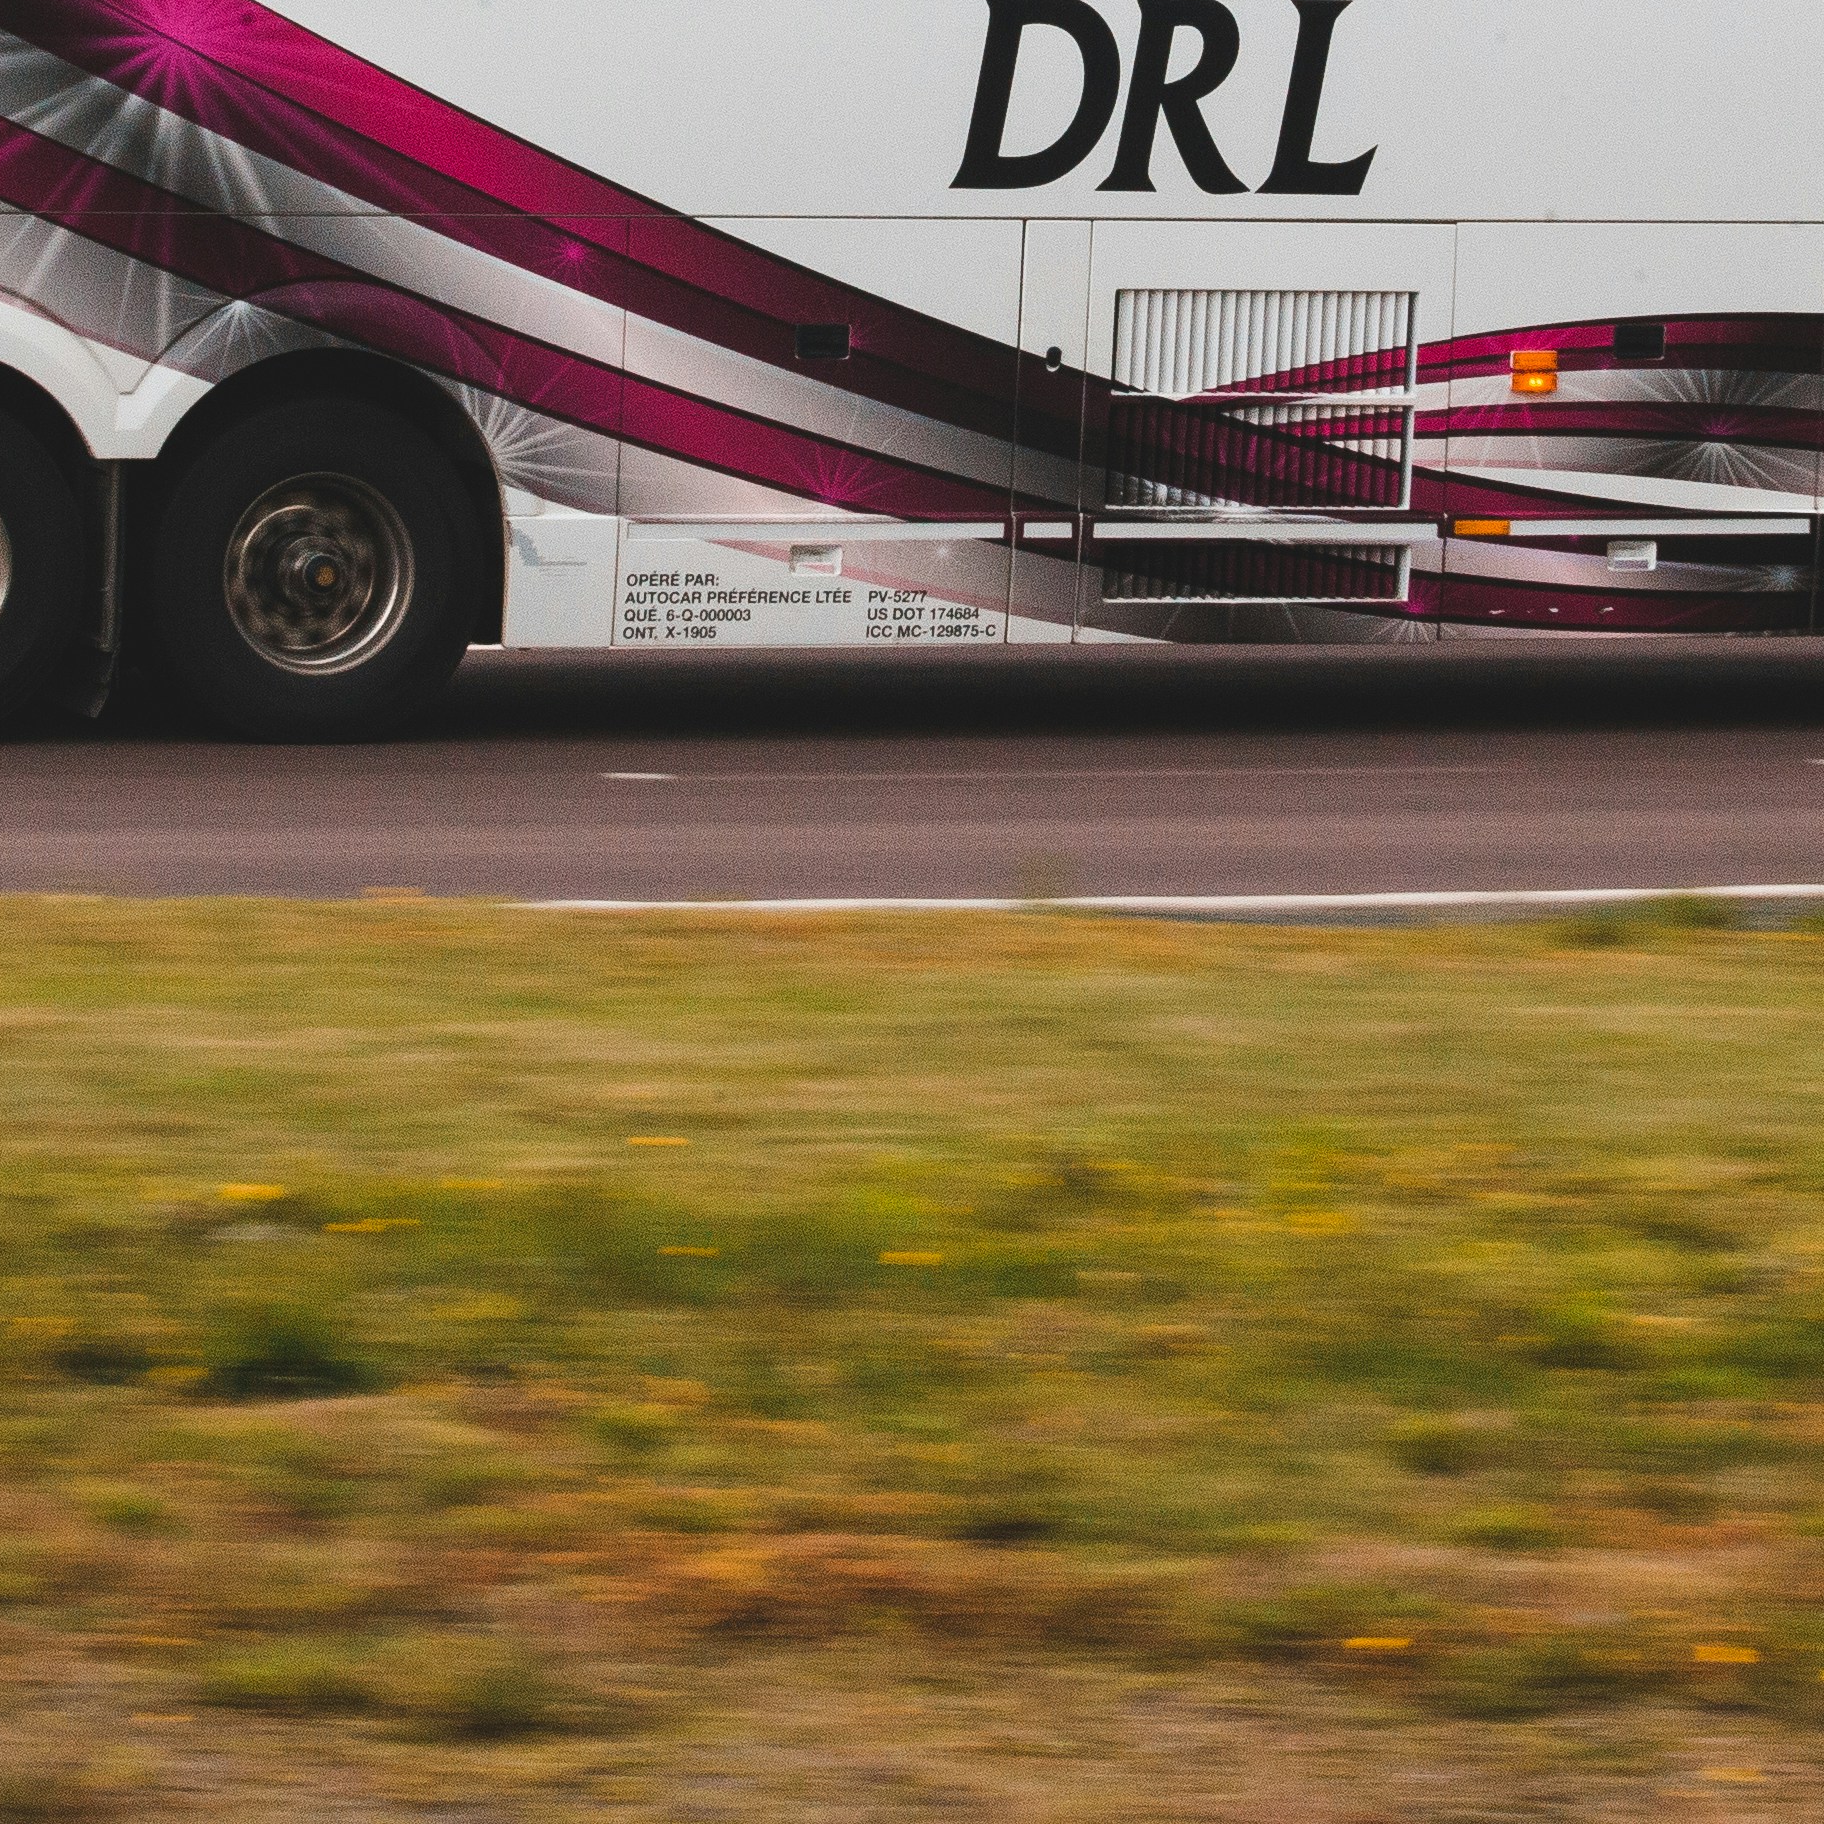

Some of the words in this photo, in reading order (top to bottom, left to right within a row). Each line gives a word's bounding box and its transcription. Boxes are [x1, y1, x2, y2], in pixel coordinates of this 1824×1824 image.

[626, 570, 680, 587] OPÉRÉ
[684, 573, 719, 587] PAR:
[625, 591, 702, 604] AUTOCAR
[707, 587, 811, 604] PRÉFÉRENCE
[816, 587, 852, 604] LTÉE
[868, 590, 927, 603] PV-5277
[624, 605, 661, 622] QUÉ.
[666, 608, 751, 622] 6-Q-000003
[867, 608, 888, 620] US
[892, 607, 925, 620] DOT
[930, 607, 980, 620] 174684
[623, 627, 658, 639] ONT.
[665, 626, 717, 639] X-1905
[866, 625, 892, 638] ICC
[897, 624, 996, 638] MC-129875-C
